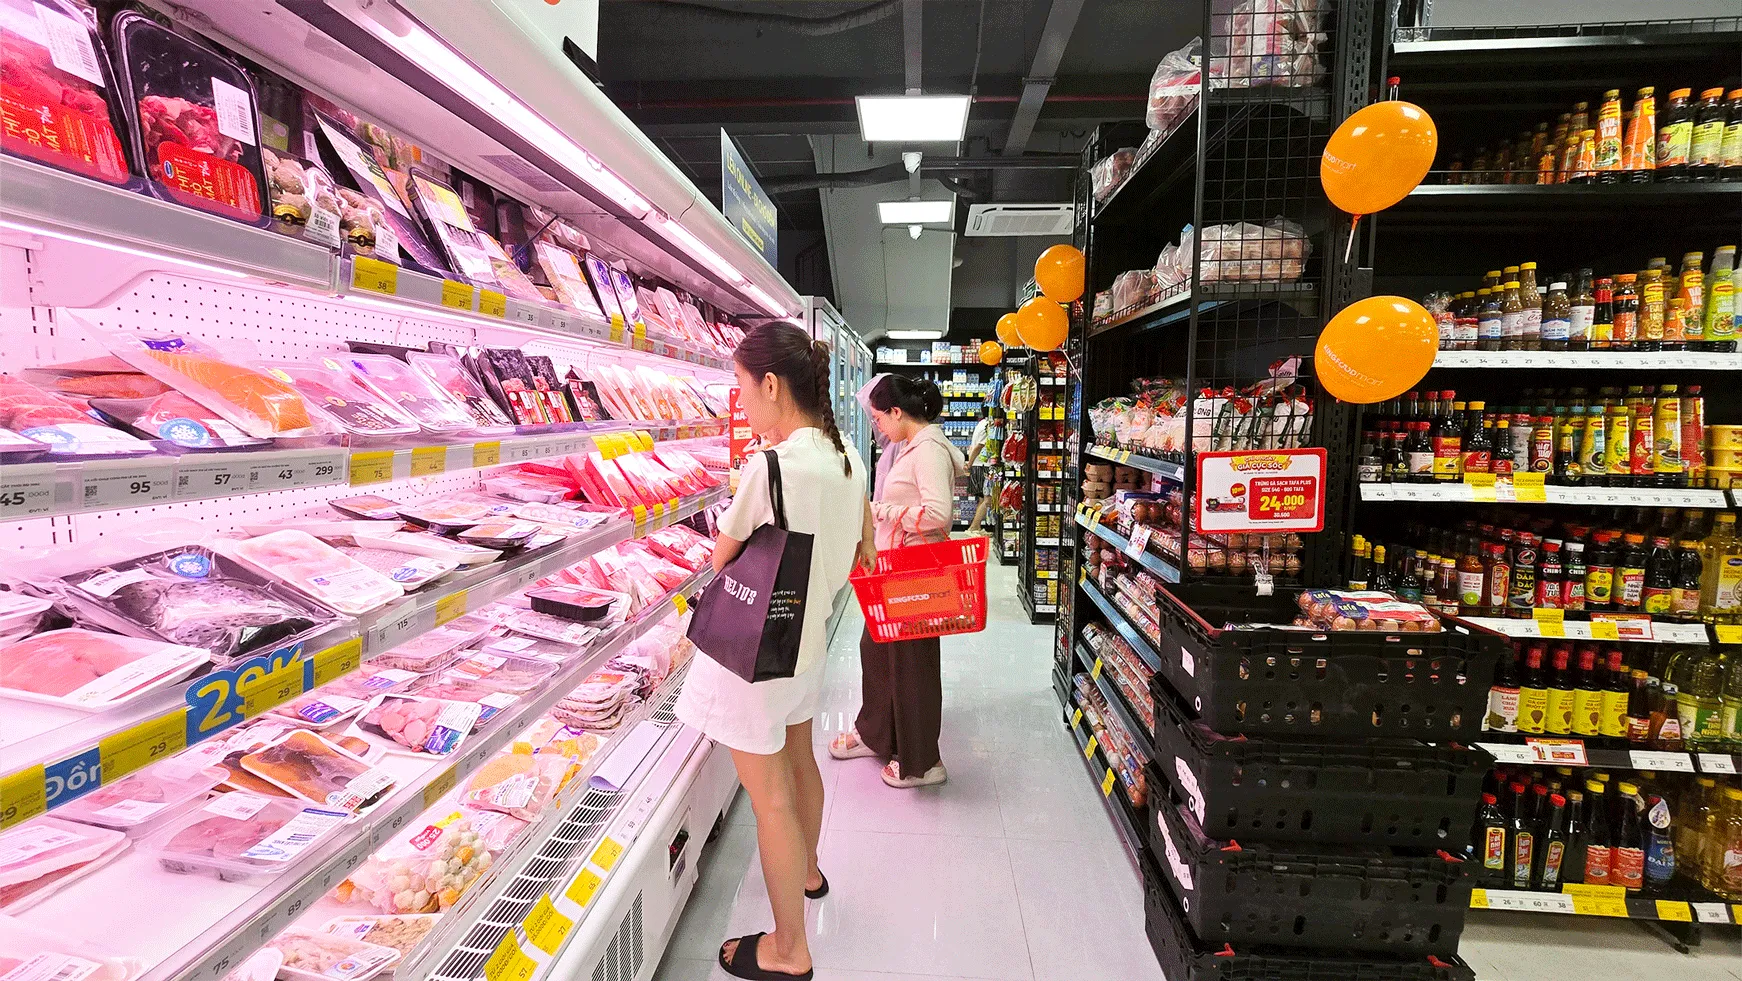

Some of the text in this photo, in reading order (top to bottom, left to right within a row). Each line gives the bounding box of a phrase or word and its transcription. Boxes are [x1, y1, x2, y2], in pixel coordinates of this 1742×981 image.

[378, 282, 387, 290] 38
[278, 470, 293, 480] 43
[316, 466, 333, 476] 299
[374, 470, 383, 478] 75
[214, 474, 231, 485] 57
[130, 481, 151, 494] 95
[0, 491, 26, 506] 45
[1260, 495, 1304, 512] 24.000
[888, 590, 950, 604] KINGFOODmart
[397, 619, 408, 631] 115
[340, 660, 351, 672] 29
[277, 688, 290, 699] 29
[150, 742, 166, 756] 29
[392, 816, 403, 829] 69
[346, 856, 358, 869] 39
[288, 900, 301, 916] 89
[558, 925, 566, 936] 27
[213, 958, 230, 975] 75
[518, 968, 528, 979] 57
